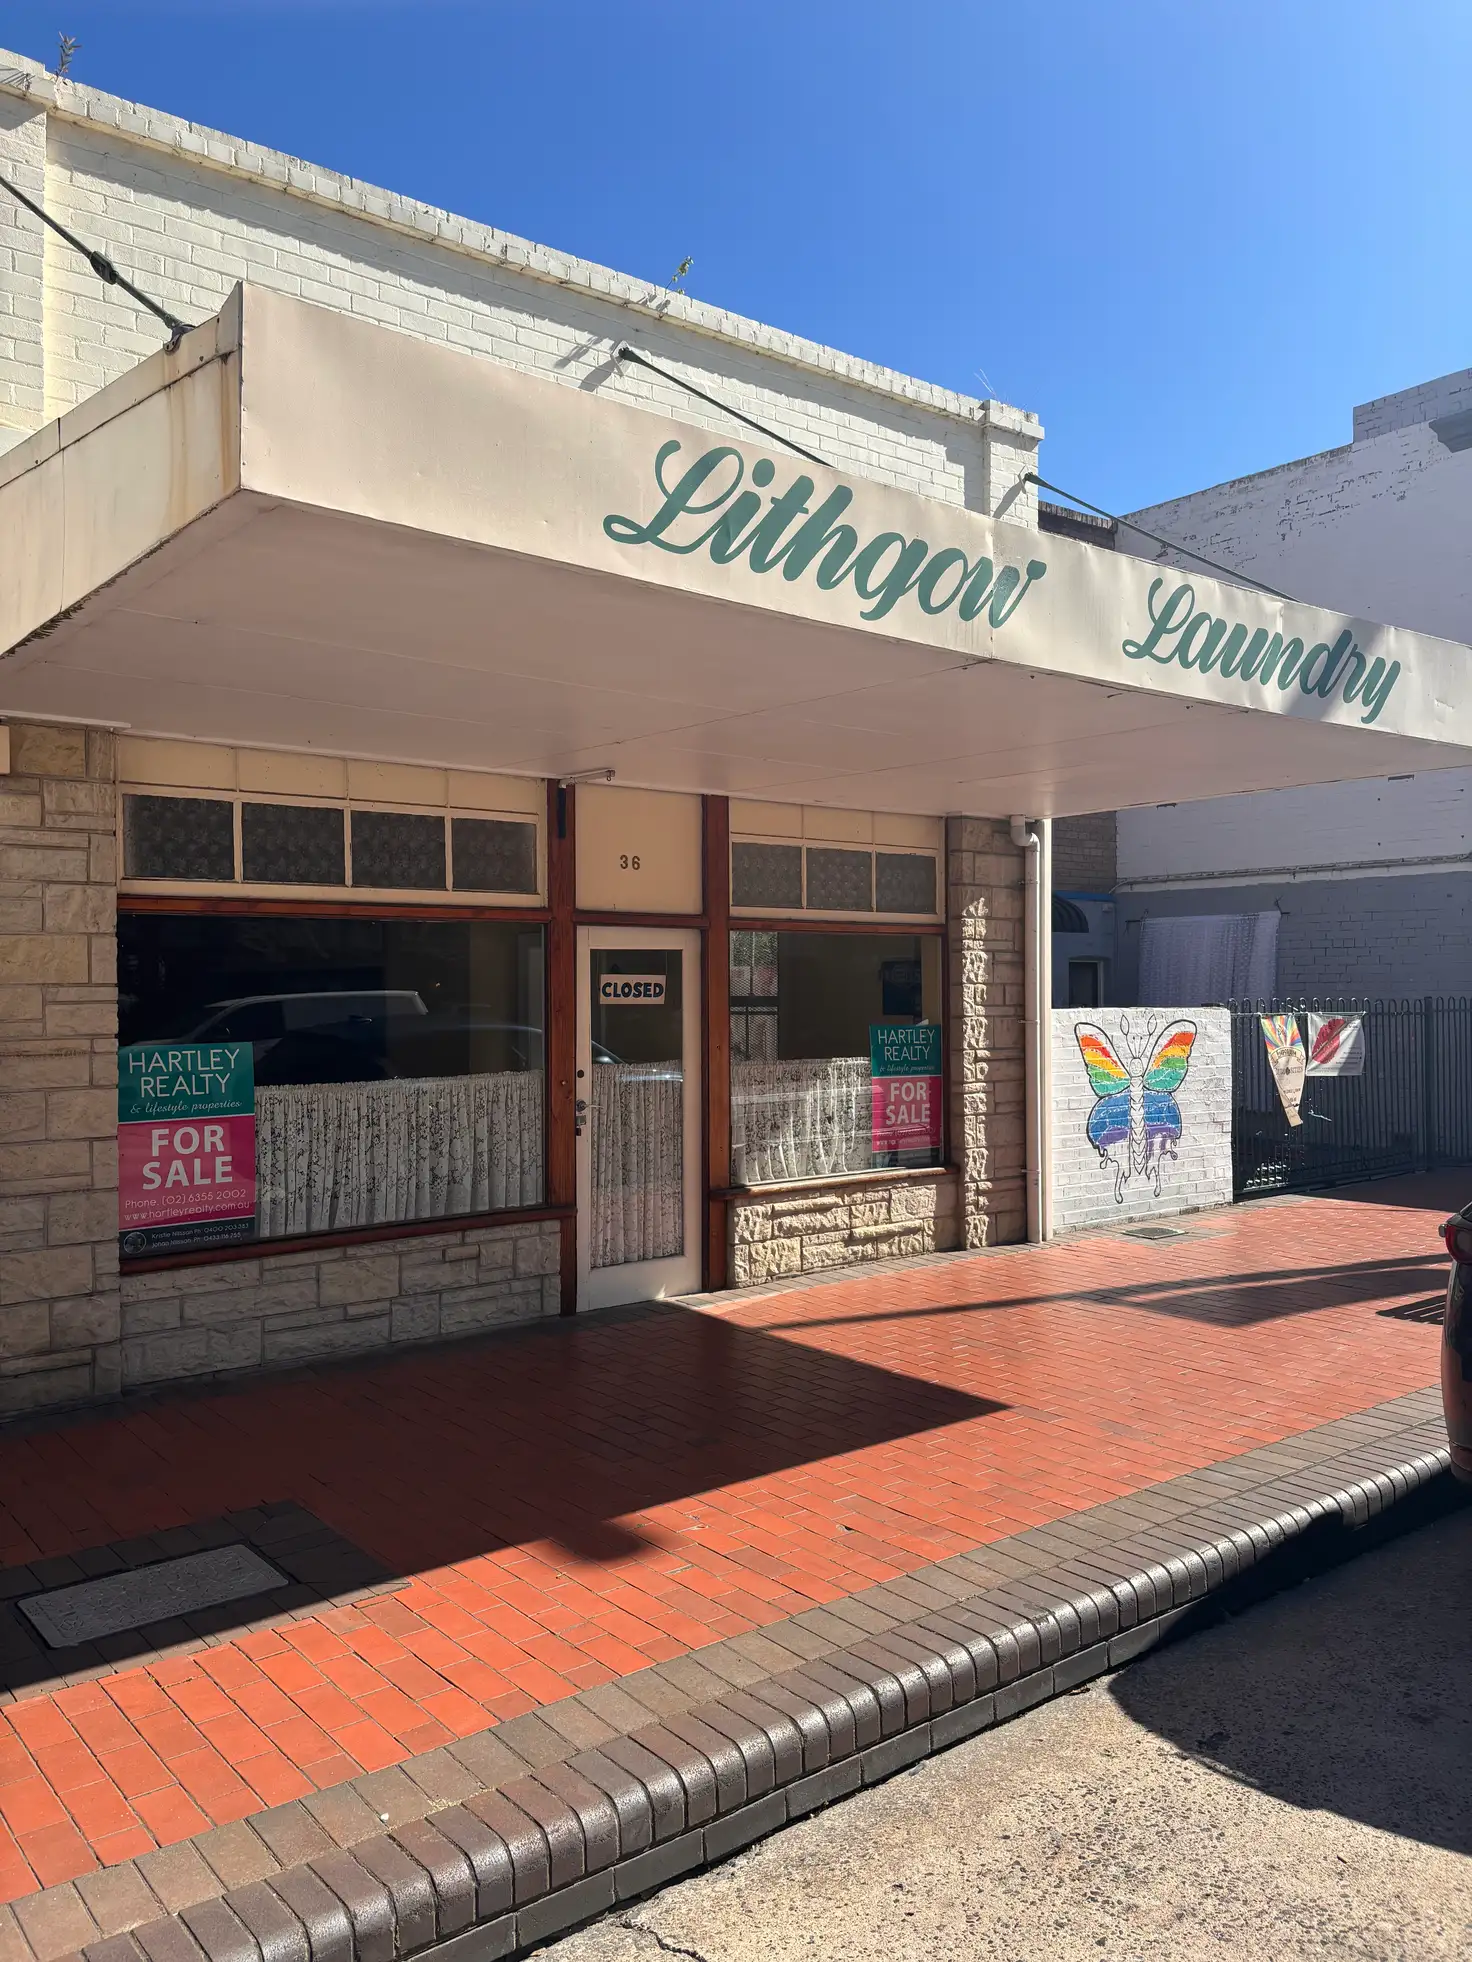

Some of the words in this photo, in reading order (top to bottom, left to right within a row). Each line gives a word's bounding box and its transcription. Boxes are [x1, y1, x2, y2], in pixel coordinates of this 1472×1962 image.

[602, 439, 1048, 629] Lithgow
[1122, 577, 1401, 725] Laundry
[619, 855, 641, 870] 36
[601, 982, 664, 998] CLOSED
[877, 1029, 935, 1045] HARTLEY
[128, 1048, 240, 1074] HARTLEY
[884, 1046, 930, 1061] REALTY
[140, 1072, 231, 1098] REALTY
[890, 1081, 927, 1102] FOR
[145, 1101, 188, 1116] lifestyle
[191, 1099, 242, 1113] properties
[885, 1103, 931, 1126] SALE
[151, 1125, 225, 1157] FOR
[142, 1156, 233, 1190] SALE
[125, 1198, 160, 1209] Phone.
[162, 1193, 186, 1206] (02)
[189, 1193, 214, 1203] 6355
[216, 1188, 247, 1200] 2002
[123, 1200, 250, 1222] www.hartleyrealty.com.au
[203, 1225, 224, 1234] 0400
